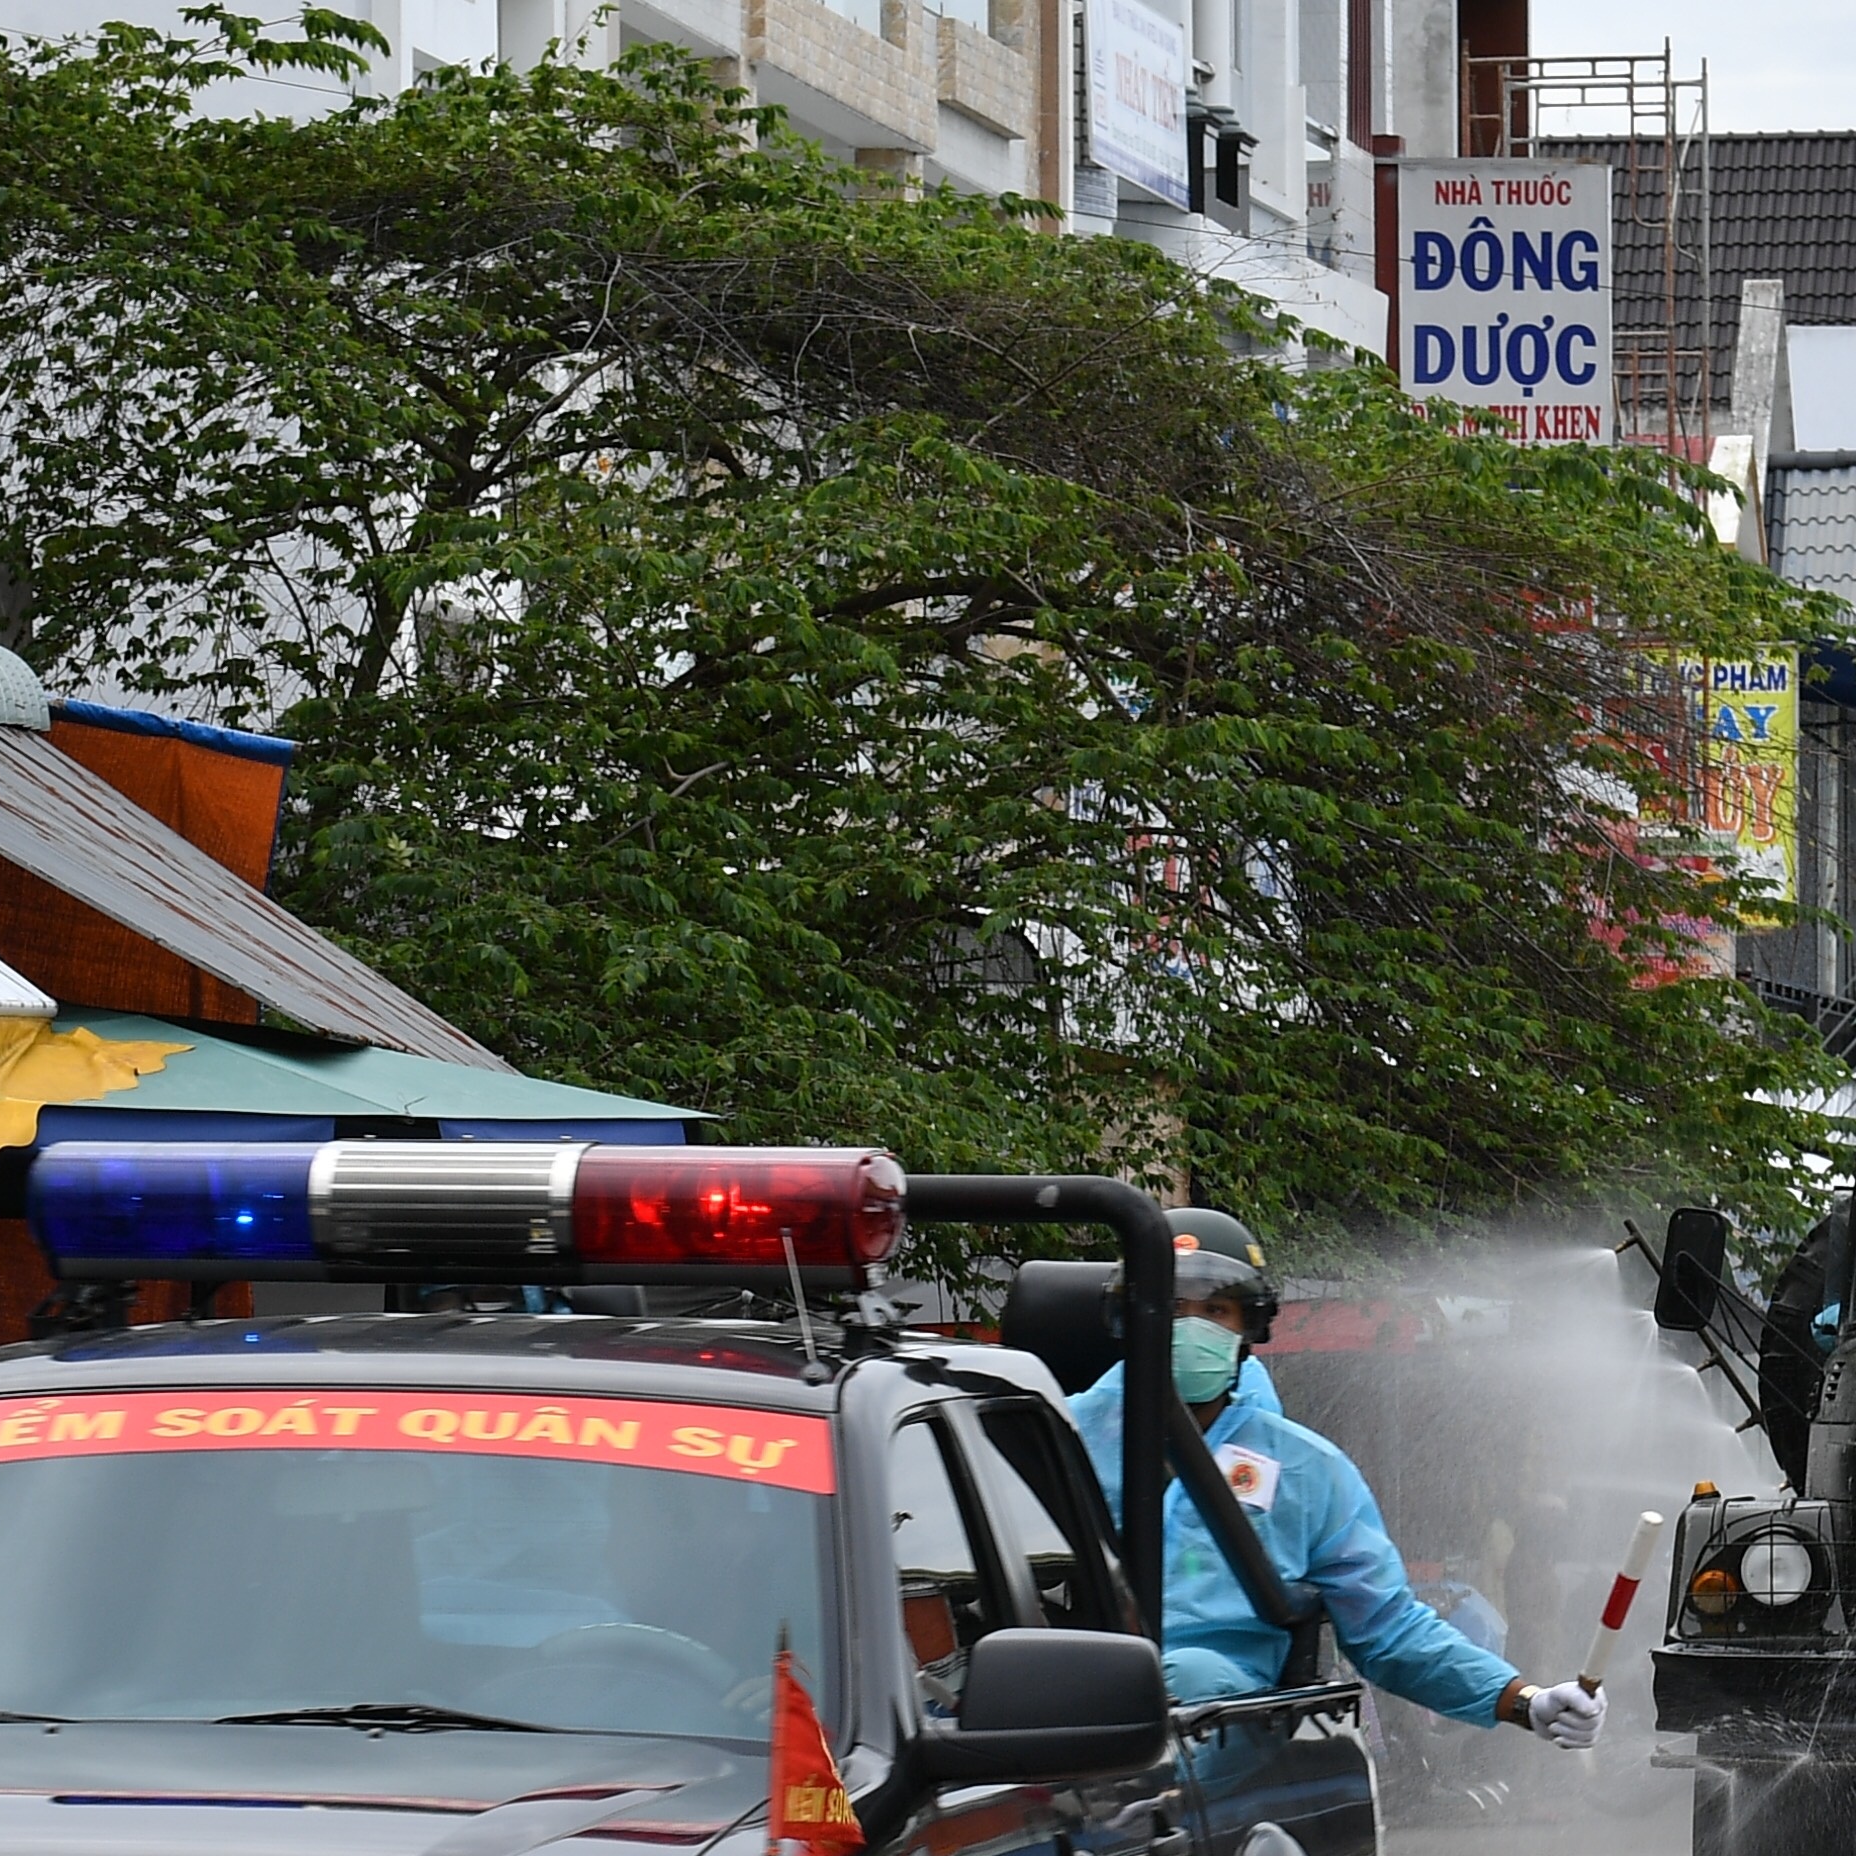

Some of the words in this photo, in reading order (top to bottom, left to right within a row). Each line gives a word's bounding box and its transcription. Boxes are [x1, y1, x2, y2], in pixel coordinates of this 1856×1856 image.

[1434, 174, 1482, 205] NHÀ
[1491, 171, 1572, 206] THUỐC
[1411, 216, 1599, 292] ĐÔNG
[1413, 312, 1597, 398] DƯỢC
[1535, 406, 1601, 440] KHEN
[1712, 704, 1778, 741] AY
[147, 1398, 380, 1439] SOÁT
[398, 1405, 641, 1450] QUÂN
[667, 1425, 799, 1475] SỰ
